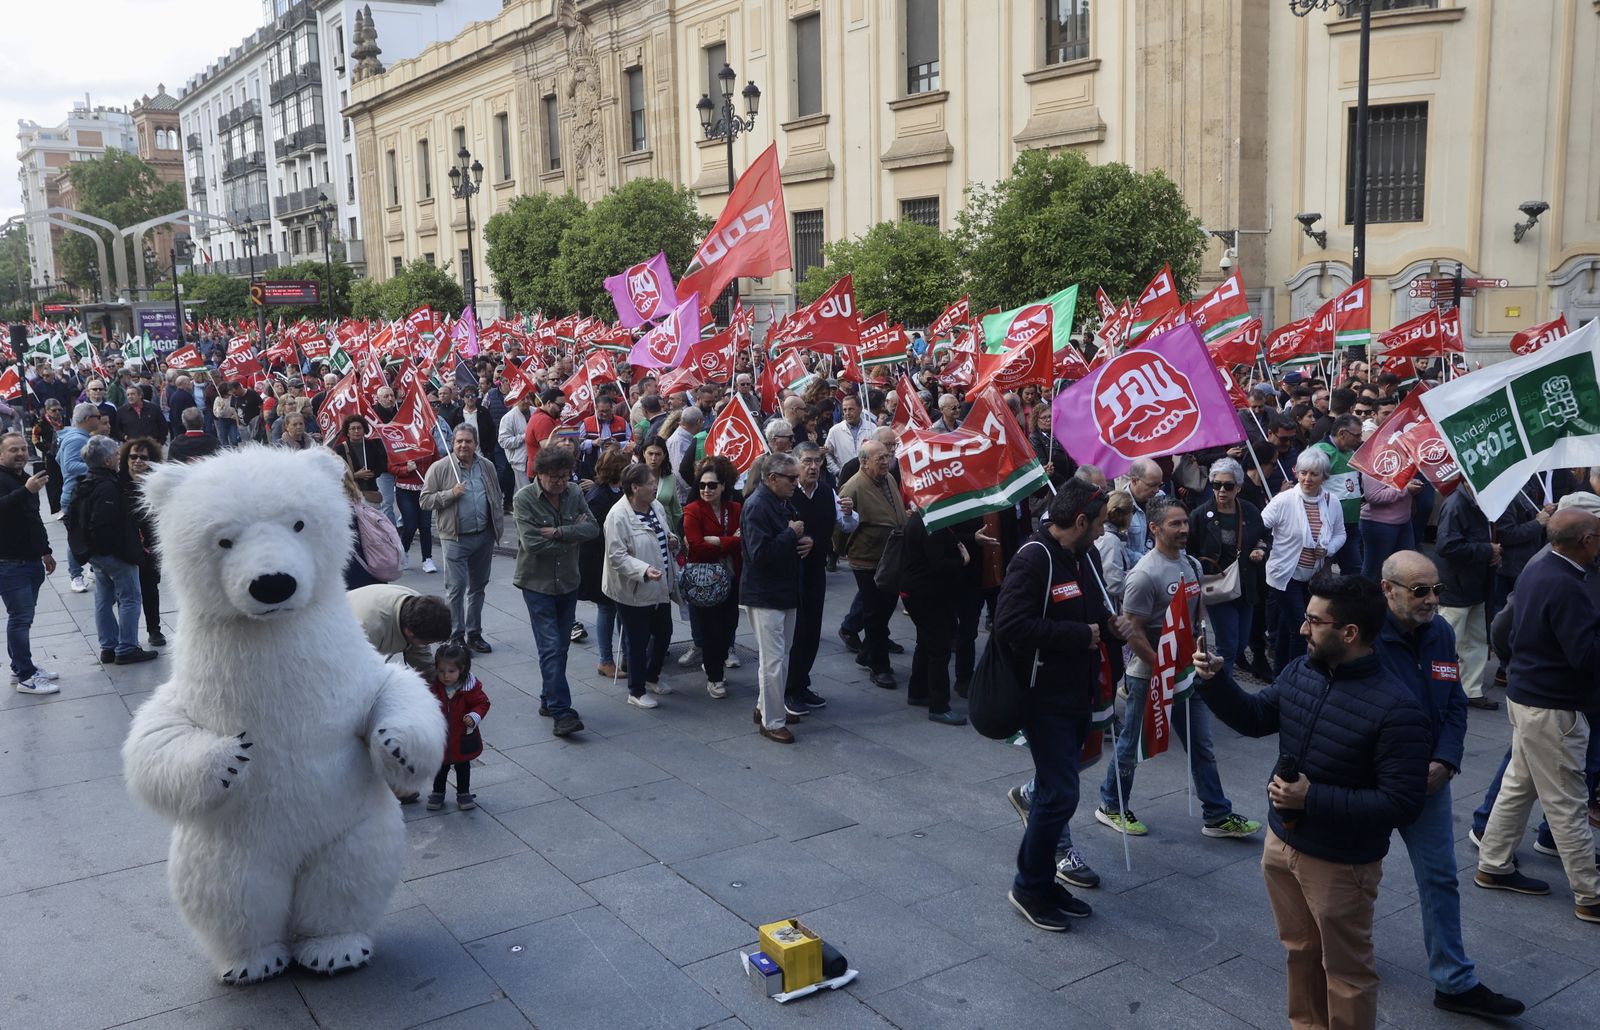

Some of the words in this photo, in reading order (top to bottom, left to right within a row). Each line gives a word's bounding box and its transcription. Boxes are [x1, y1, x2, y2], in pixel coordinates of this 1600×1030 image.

[1453, 406, 1508, 446] Andalucía
[1461, 421, 1517, 476] PSOE
[1150, 675, 1164, 739] Sevilla
